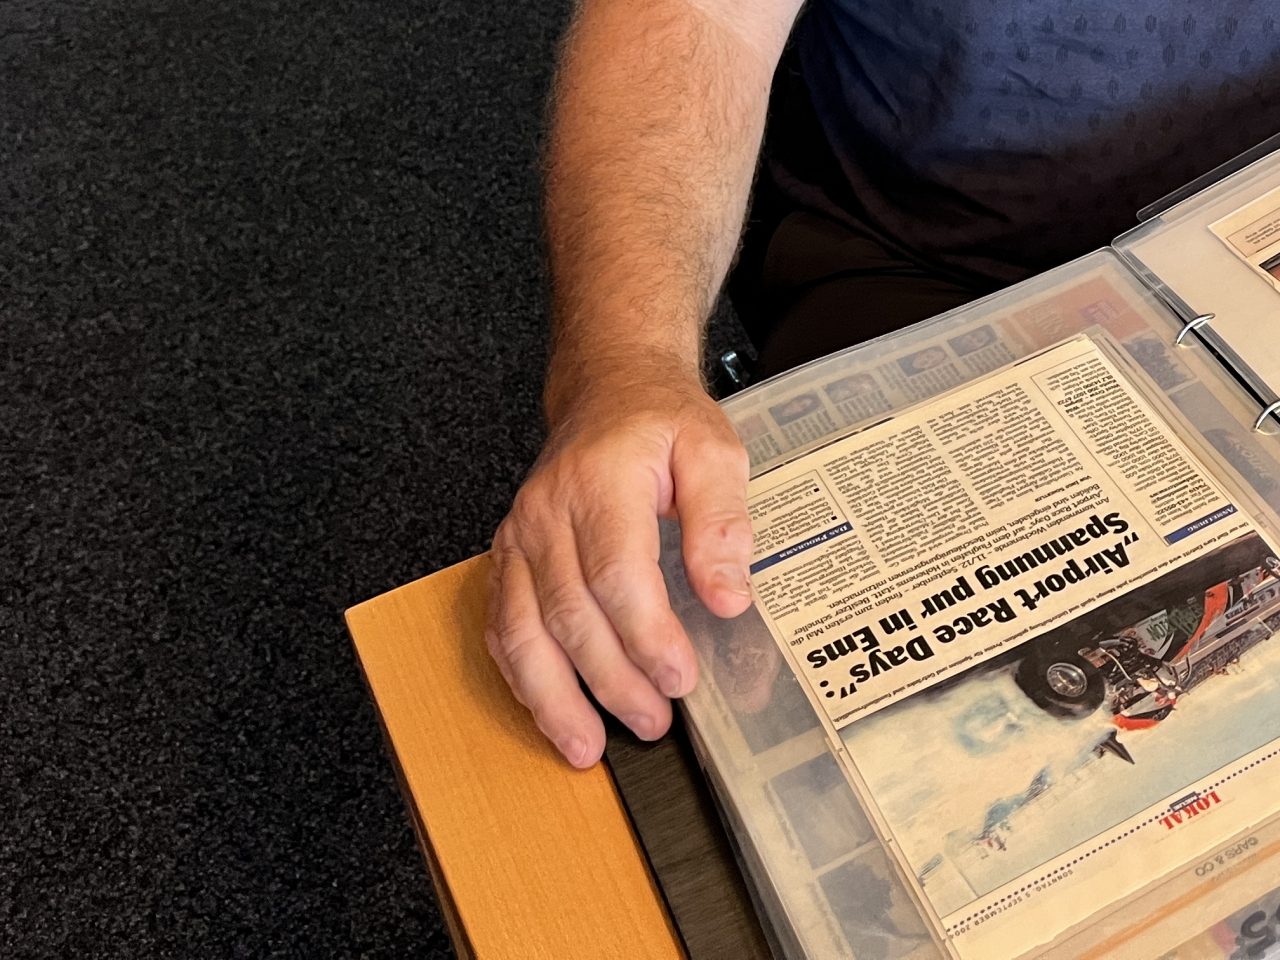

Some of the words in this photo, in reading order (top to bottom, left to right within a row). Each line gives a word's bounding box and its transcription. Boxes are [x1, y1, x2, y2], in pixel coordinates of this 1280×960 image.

[1069, 483, 1100, 499] Boliden
[1094, 496, 1109, 506] Am
[1050, 504, 1072, 517] Race
[1051, 496, 1069, 508] sind
[1006, 504, 1051, 527] eingeladen,
[1045, 503, 1095, 528] kommenden
[1187, 506, 1236, 532] ANMELDUNG
[828, 524, 847, 535] DAS
[985, 525, 1007, 537] beim
[991, 532, 1011, 543] dem
[993, 526, 1046, 552] Wochenende
[1011, 525, 1025, 537] auf
[779, 533, 827, 558] PROGRAMM
[950, 541, 992, 562] Flughafen
[975, 512, 1128, 588] Spannung
[887, 535, 985, 581] Beschleunigungsrennen
[940, 559, 950, 567] in
[895, 564, 940, 587] Hohenems
[912, 565, 958, 590] September
[834, 596, 870, 616] Besitzer
[874, 591, 903, 606] finden
[920, 576, 974, 618] pur
[854, 603, 873, 616] zum
[793, 613, 832, 635] schneller
[824, 613, 853, 630] ersten
[878, 608, 917, 634] in
[933, 598, 1015, 643] Race
[789, 636, 804, 646] die
[805, 627, 824, 640] Mal
[806, 626, 879, 668] Ems
[1158, 791, 1220, 828] LOKAL
[1193, 858, 1214, 876] CO
